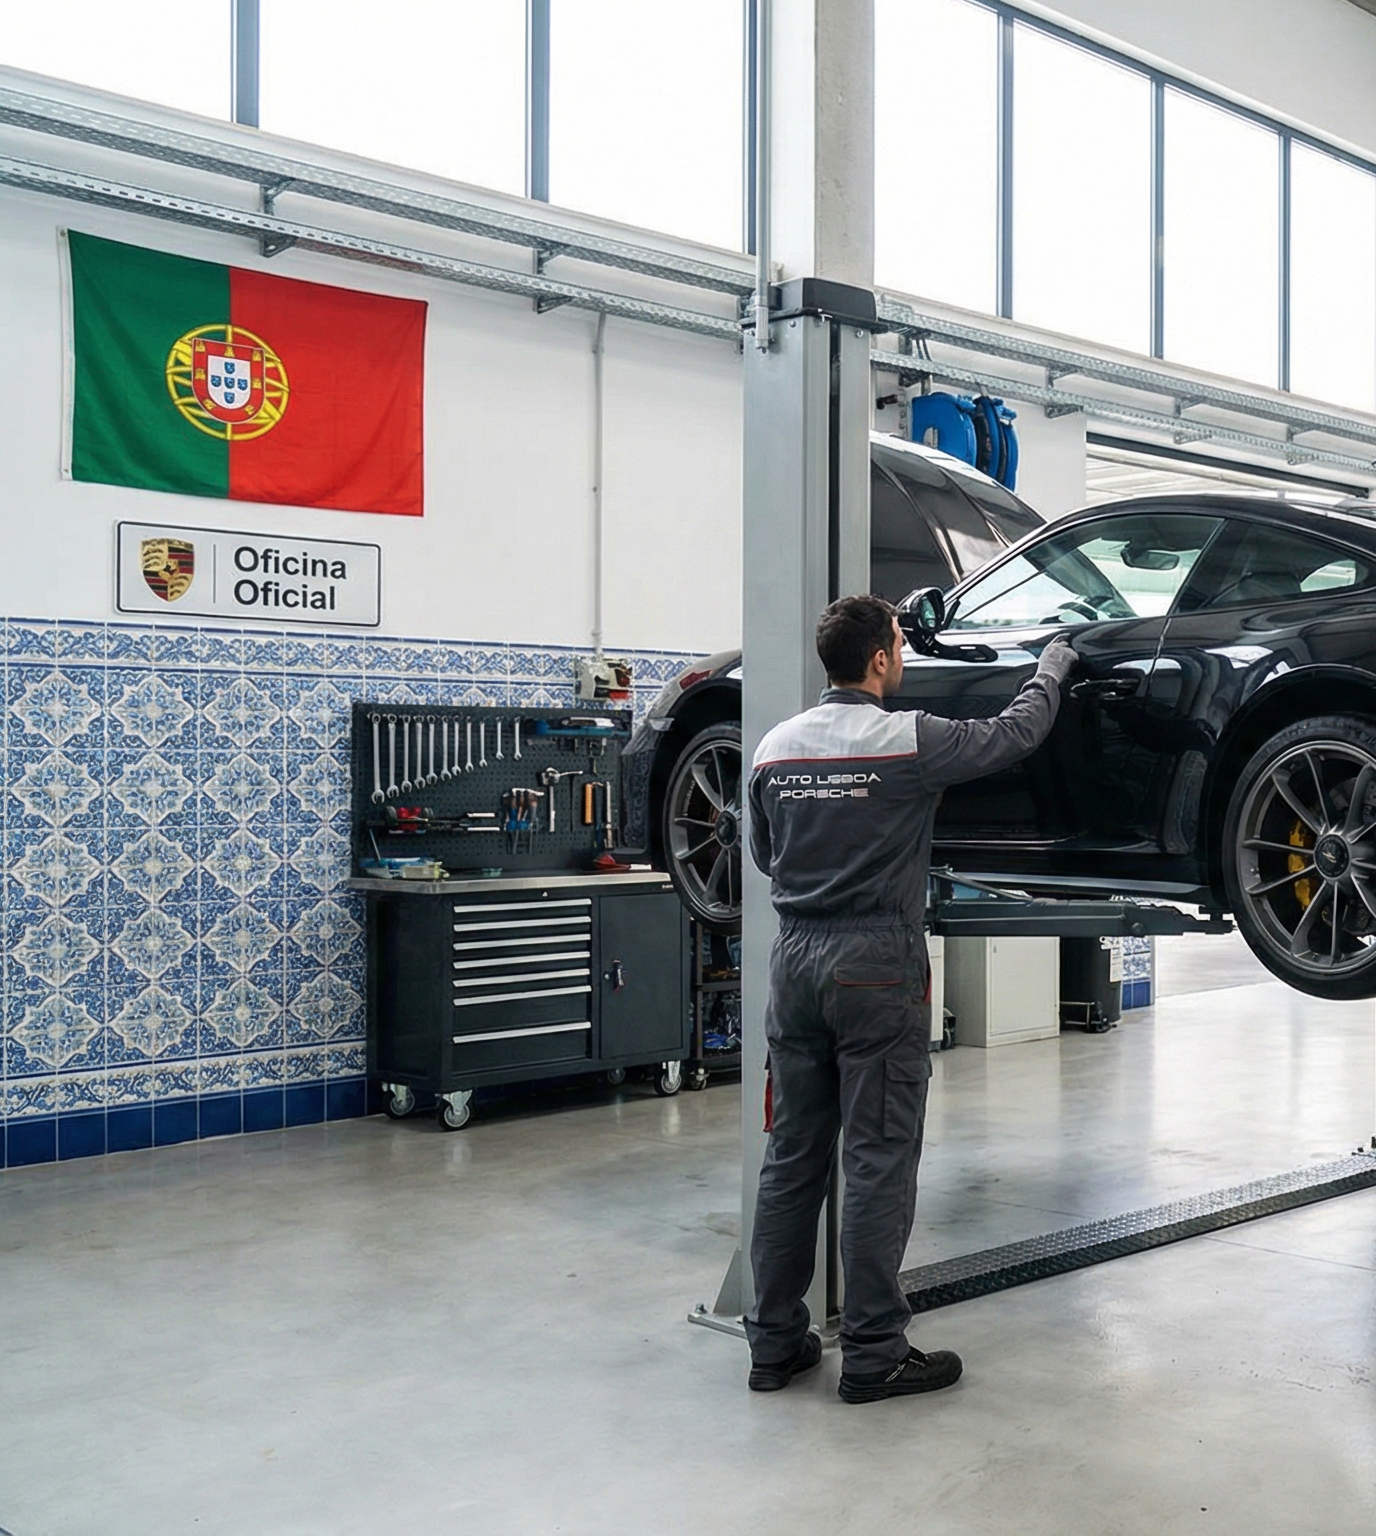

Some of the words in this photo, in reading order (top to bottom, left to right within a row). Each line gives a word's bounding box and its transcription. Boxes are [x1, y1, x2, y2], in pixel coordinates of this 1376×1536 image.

[234, 546, 347, 580] Oficina
[233, 579, 336, 611] Oficial
[767, 775, 812, 788] AUTO
[779, 788, 869, 799] PORSCHE
